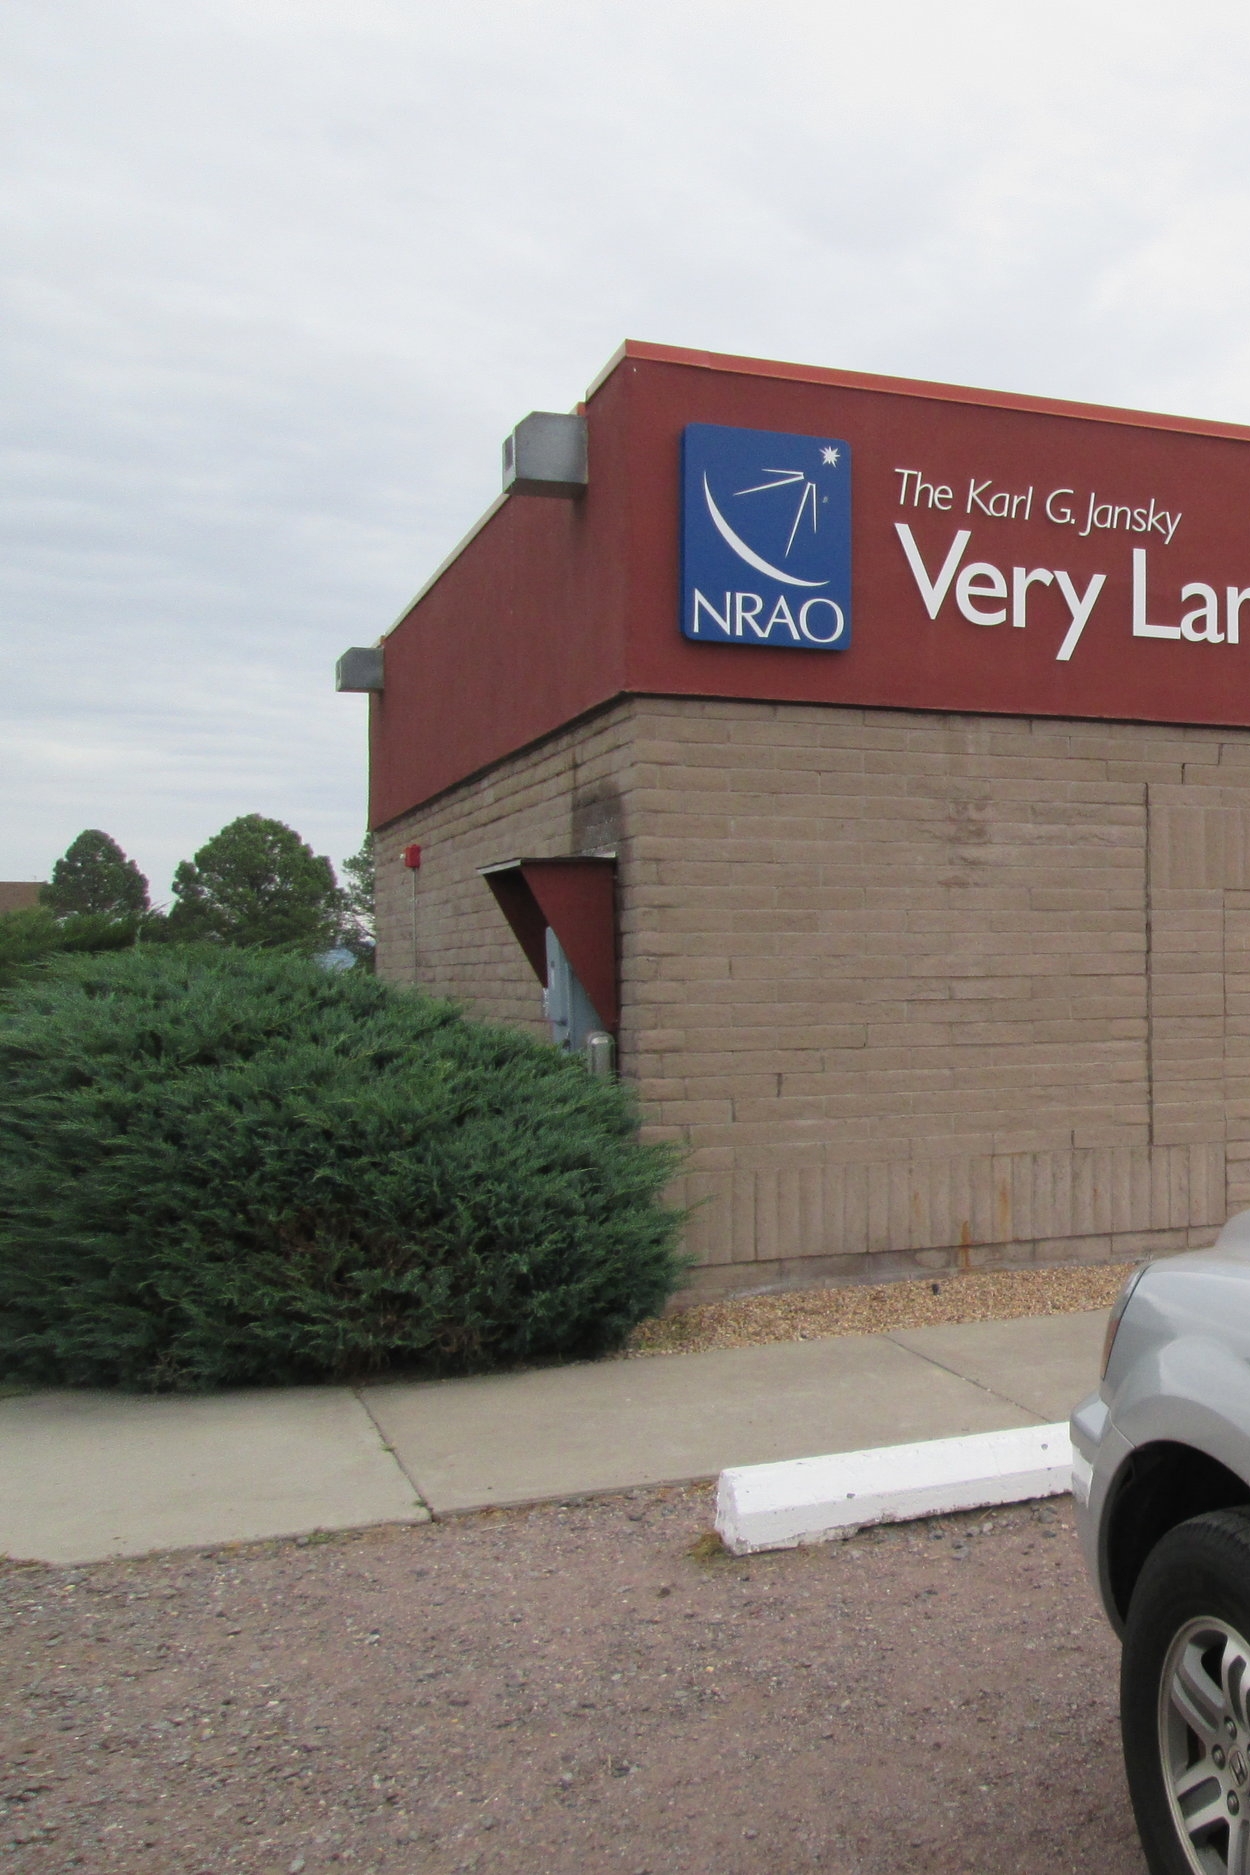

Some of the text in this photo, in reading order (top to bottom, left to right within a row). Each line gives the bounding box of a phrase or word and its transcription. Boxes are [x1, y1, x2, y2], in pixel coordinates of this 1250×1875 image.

[895, 468, 1182, 544] The Karl G. Jansky
[693, 588, 845, 644] NRAO
[895, 522, 1107, 661] Very
